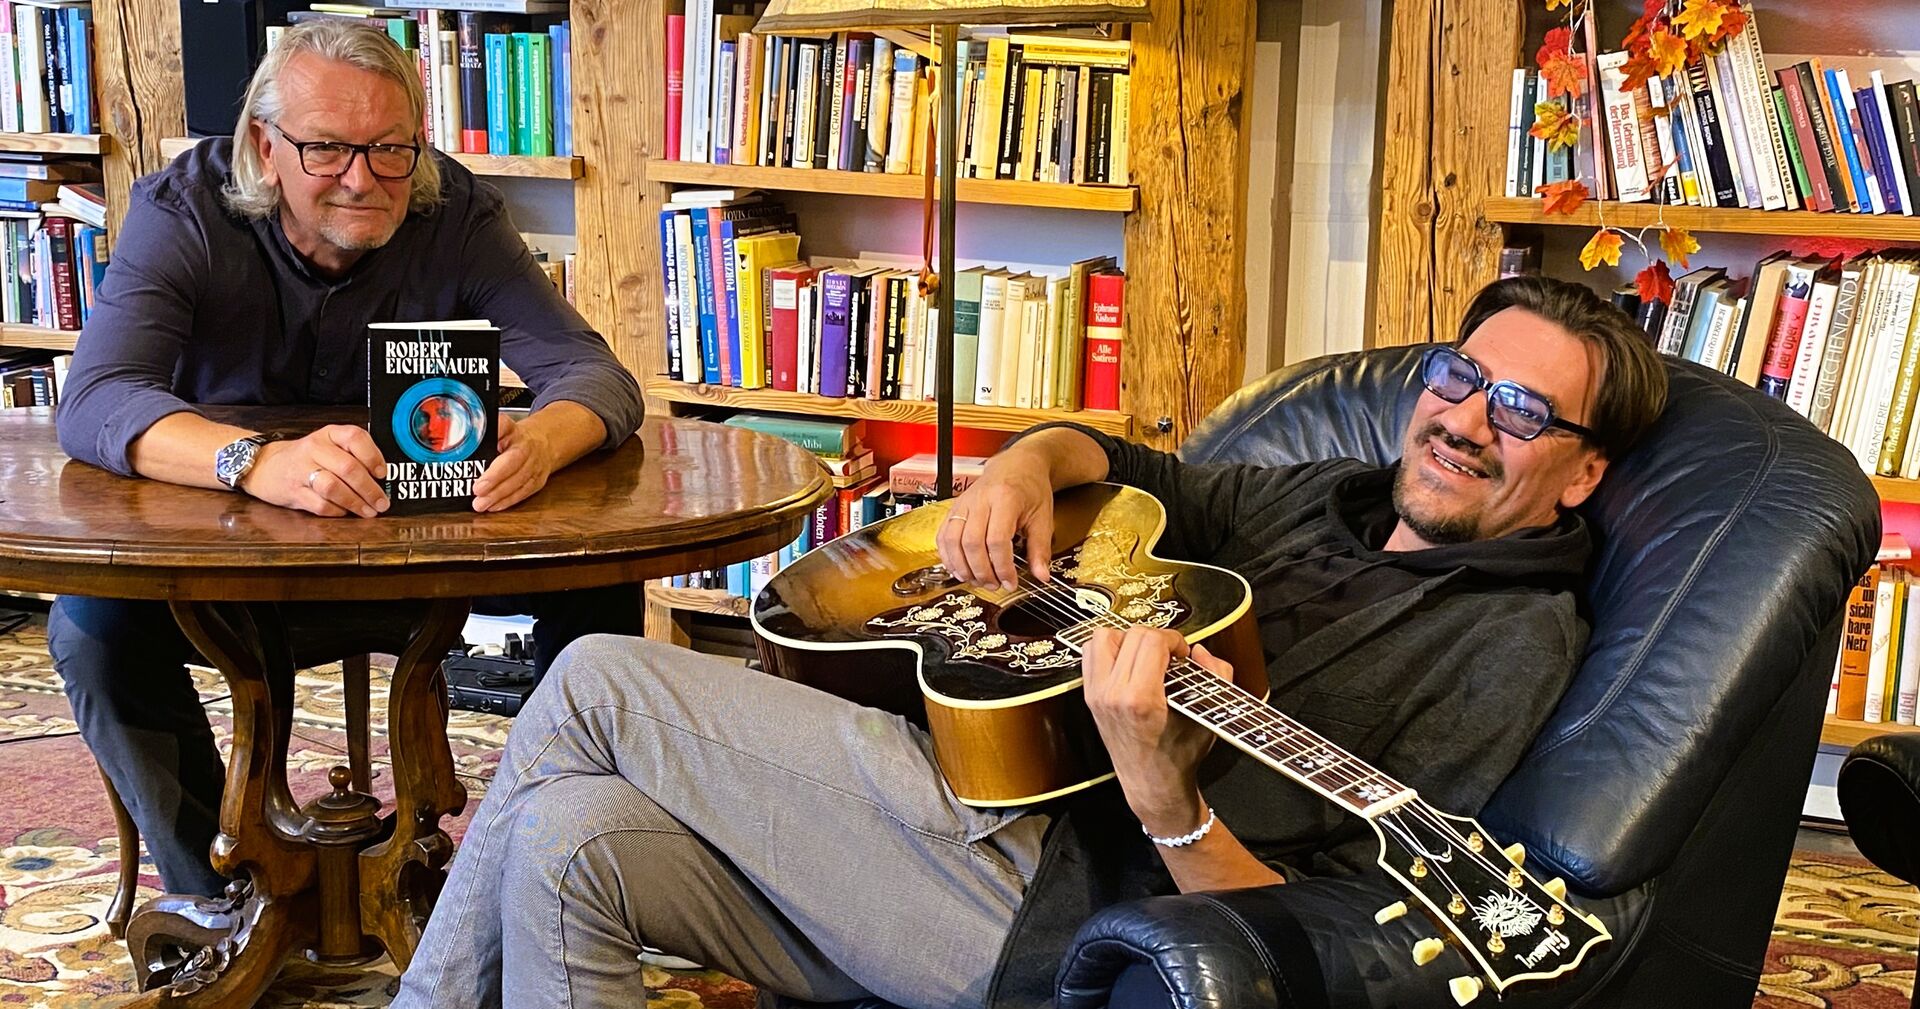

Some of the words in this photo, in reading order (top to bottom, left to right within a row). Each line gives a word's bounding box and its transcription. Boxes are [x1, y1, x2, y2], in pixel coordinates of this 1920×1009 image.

[517, 46, 526, 128] Literaturgeschichte
[533, 50, 541, 135] Literaturgeschichte
[1610, 105, 1621, 120] der
[1620, 103, 1632, 120] Das
[1612, 120, 1628, 170] Herrenburg
[1623, 123, 1638, 168] Geheimnis
[665, 219, 675, 266] Erfindungen
[723, 237, 735, 291] PORZELLAN
[667, 267, 676, 281] der
[678, 243, 692, 328] PERSONENLEXIKON
[1093, 303, 1119, 315] Ephraim
[1095, 313, 1117, 323] Kishon
[1782, 322, 1800, 348] Oper
[1816, 279, 1858, 409] GRIECHENLAND
[385, 341, 451, 359] ROBERT
[1092, 353, 1117, 363] Satiren
[1097, 344, 1112, 354] Alle
[386, 358, 489, 374] EICHENAUER
[1778, 350, 1791, 370] der
[1868, 402, 1889, 464] ORANGERIE
[801, 439, 822, 449] Alibi
[386, 462, 416, 481] DIE
[420, 459, 486, 480] AUSSEN
[398, 479, 477, 500] SEITERI
[1860, 575, 1872, 587] as
[1850, 602, 1874, 618] sicht
[1848, 619, 1871, 635] bare
[1846, 635, 1868, 651] Netz
[1514, 926, 1571, 970] Gibson
